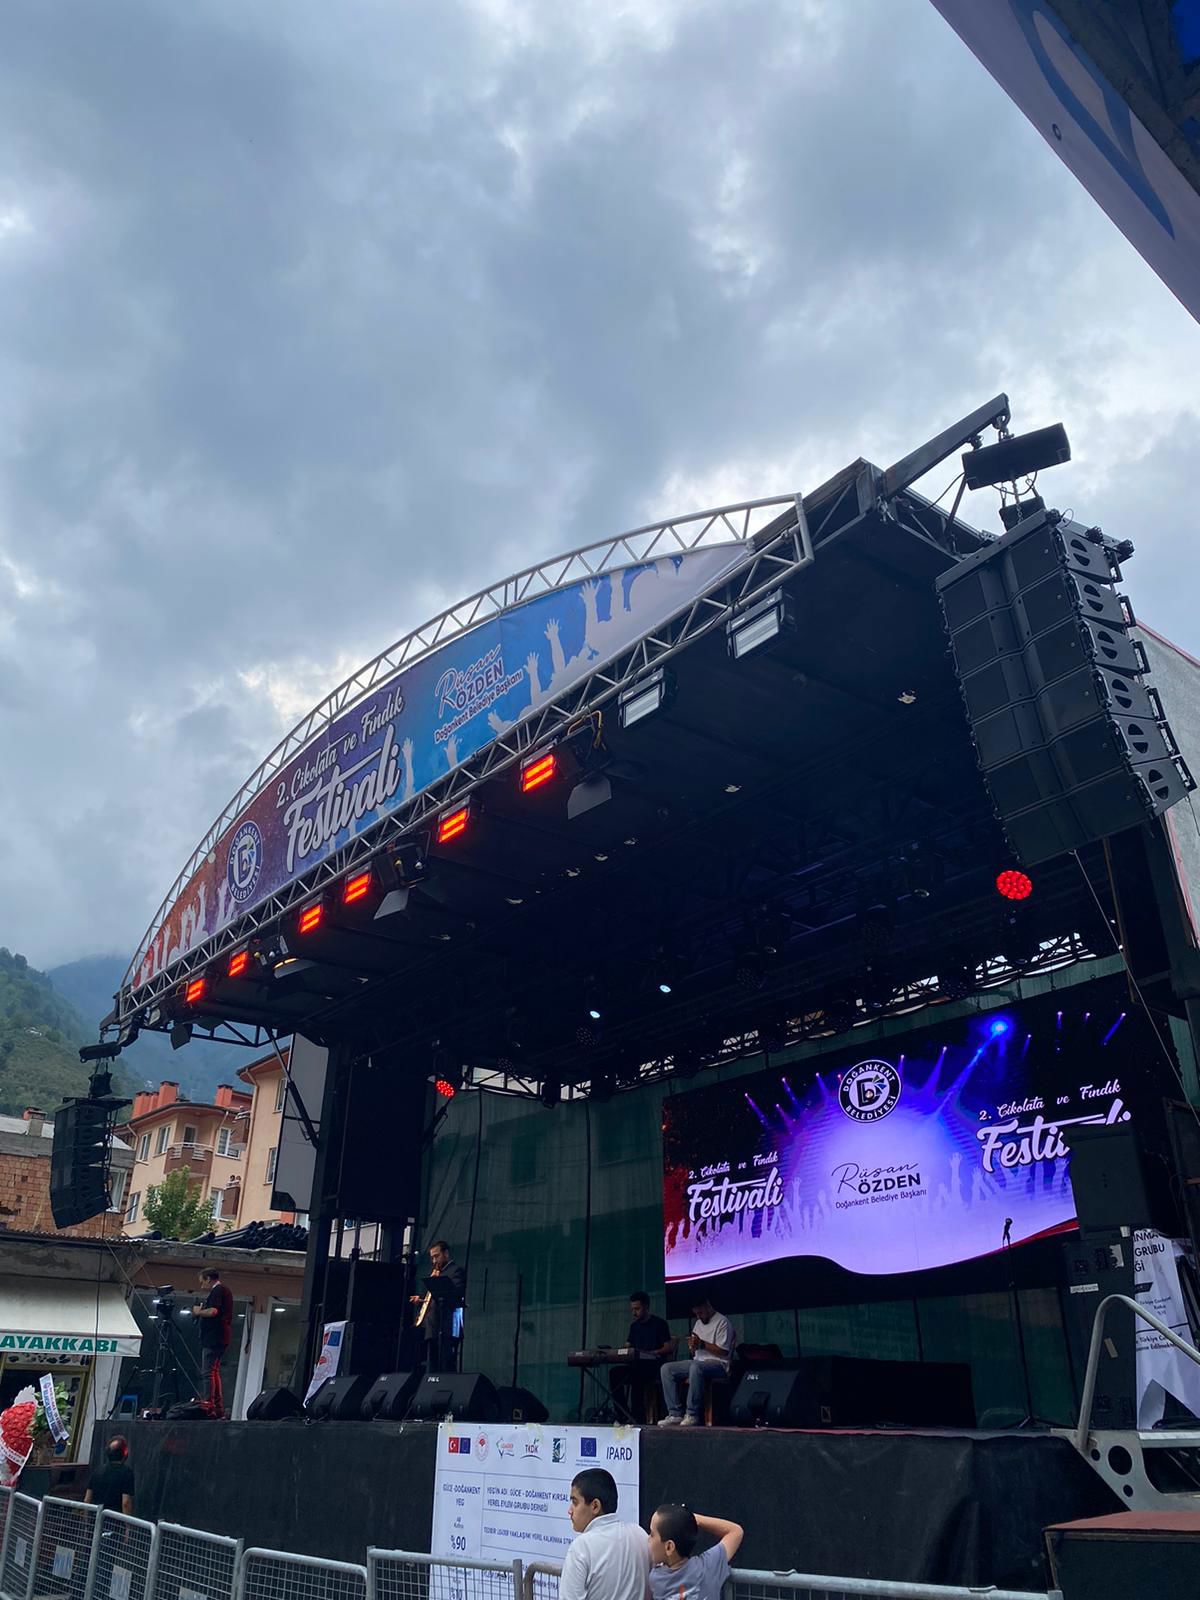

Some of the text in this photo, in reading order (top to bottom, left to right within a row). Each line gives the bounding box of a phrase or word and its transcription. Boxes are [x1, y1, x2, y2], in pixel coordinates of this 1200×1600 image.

[455, 657, 503, 711] ÖZDEN
[434, 669, 524, 744] Doğankent Belediye Başkanı
[276, 686, 405, 809] 2. Çikolata ve Fındık
[284, 723, 401, 873] Festivali
[843, 1063, 896, 1092] DOĞANKENT
[845, 1095, 897, 1120] BELEDİYESİ
[979, 1110, 992, 1121] 2.
[1056, 1095, 1070, 1105] ve
[1079, 1078, 1122, 1100] Fındık
[688, 1170, 698, 1180] 2.
[738, 1162, 748, 1170] ve
[752, 1151, 779, 1167] Fındık
[686, 1166, 784, 1222] Festivali
[858, 1172, 921, 1195] ÖZDEN
[835, 1188, 928, 1210] Doğankent Belediye Başkanı
[1134, 1243, 1166, 1258] GRUBU
[0, 1335, 119, 1353] AYAKKABI
[606, 1446, 633, 1461] IPARD
[450, 1534, 467, 1552] %90
